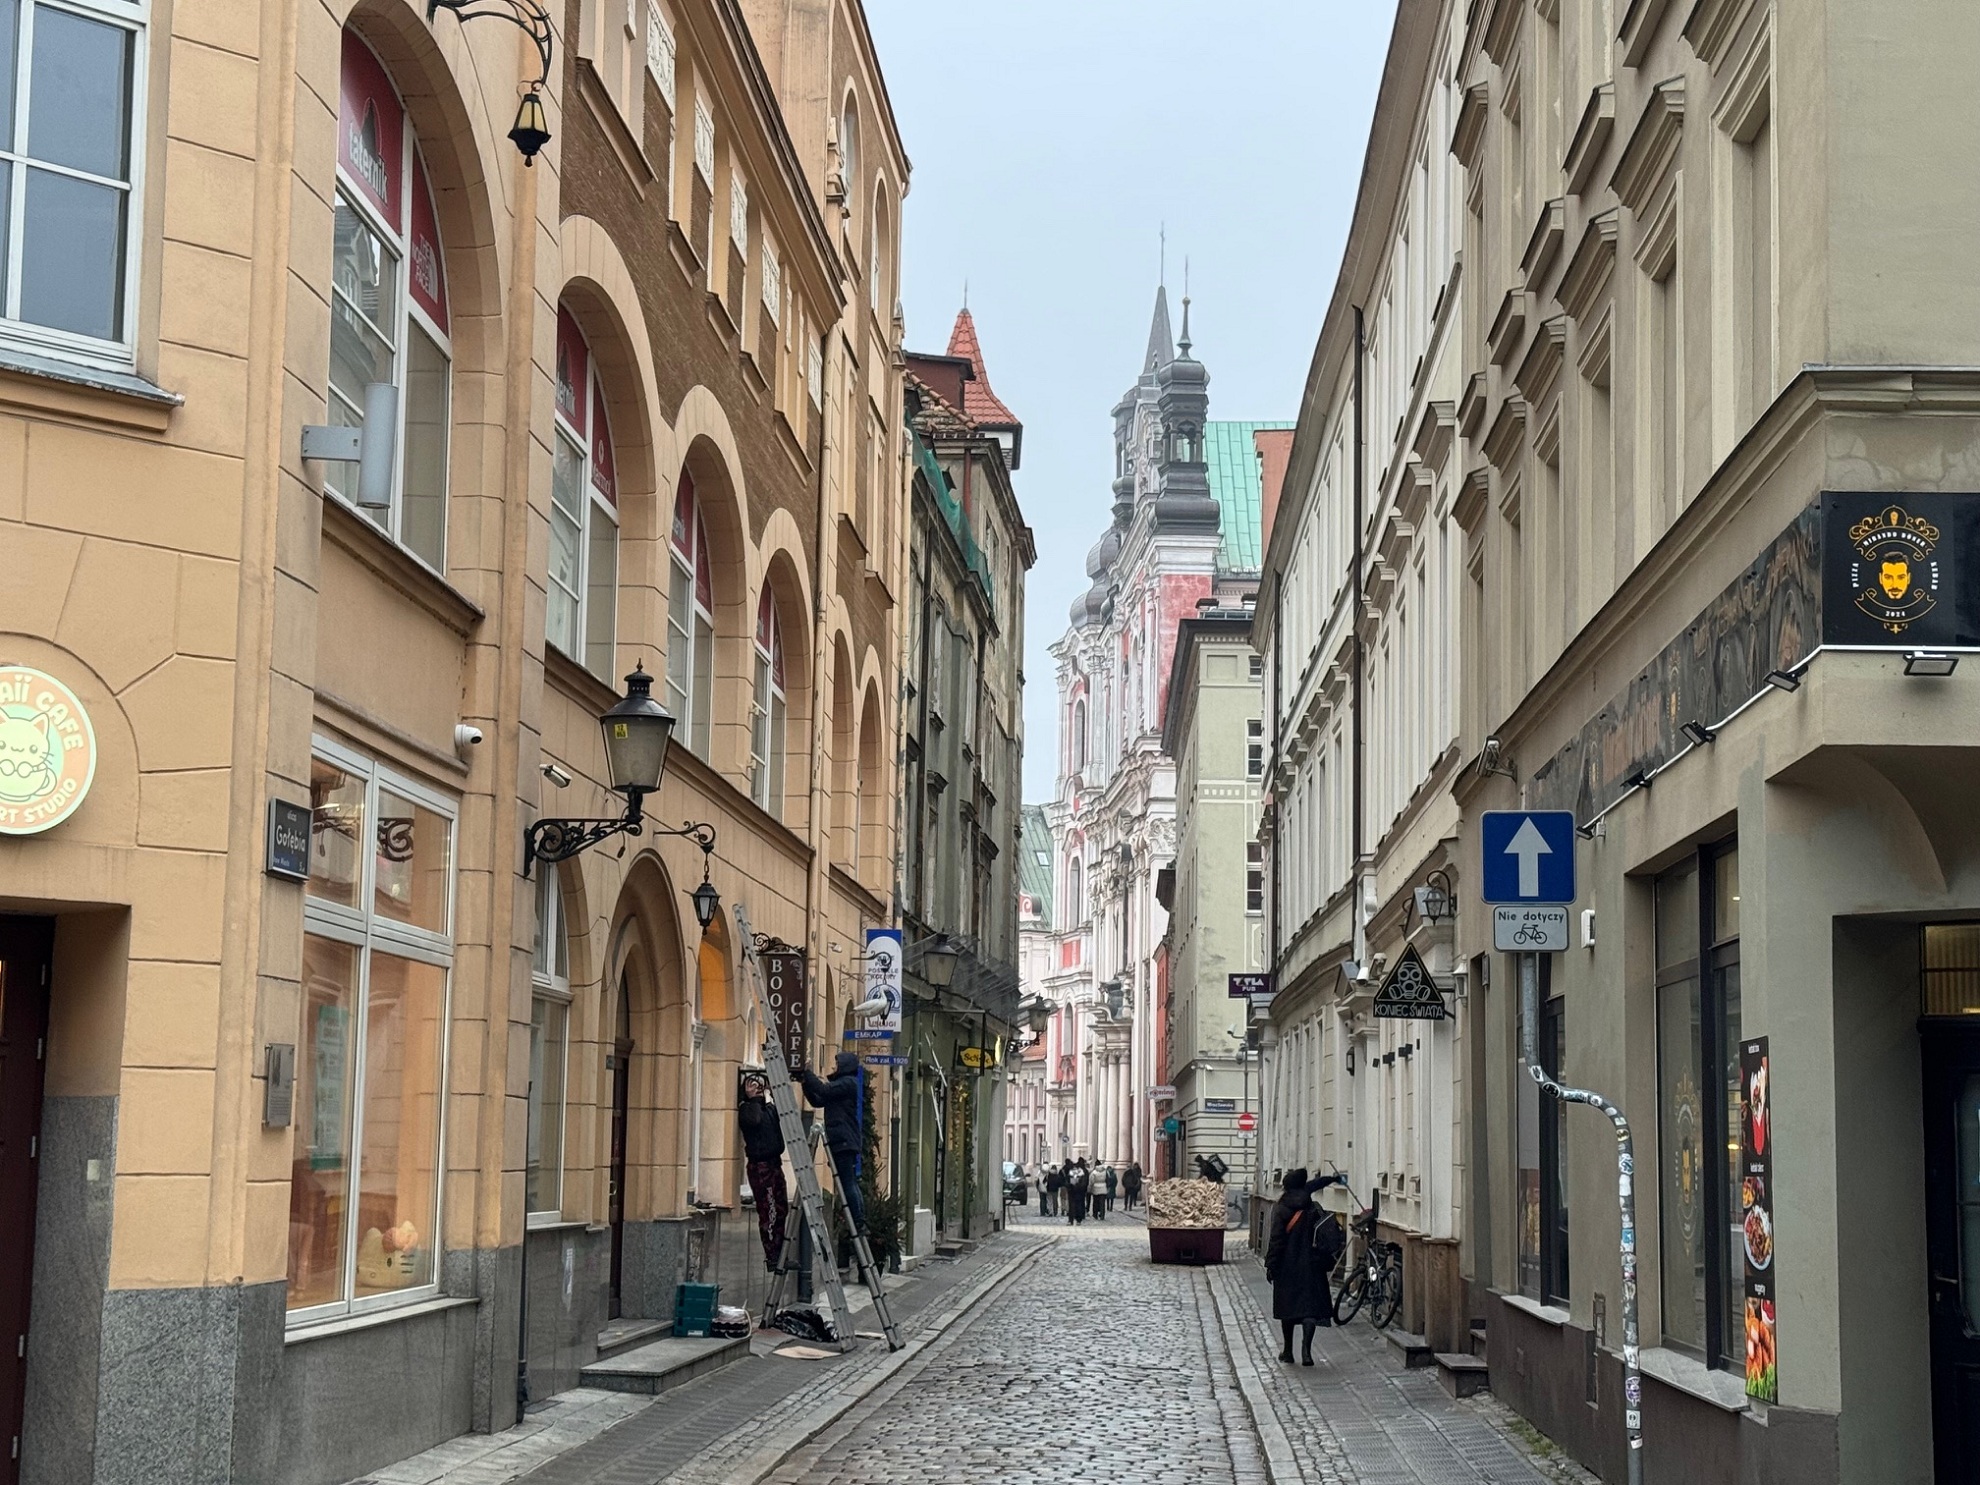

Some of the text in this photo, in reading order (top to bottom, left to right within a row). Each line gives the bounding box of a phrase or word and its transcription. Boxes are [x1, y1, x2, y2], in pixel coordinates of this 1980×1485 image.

[349, 121, 388, 204] taternik
[36, 692, 84, 750] CAFE
[23, 777, 78, 824] STUDIO
[276, 825, 306, 854] Gołębia
[1498, 910, 1564, 924] Nie dotyczy
[770, 959, 783, 1024] BOOK
[1374, 1001, 1443, 1018] KONIEC ŚWIATA
[790, 1002, 802, 1068] CAFE
[854, 1031, 882, 1039] EMKAP
